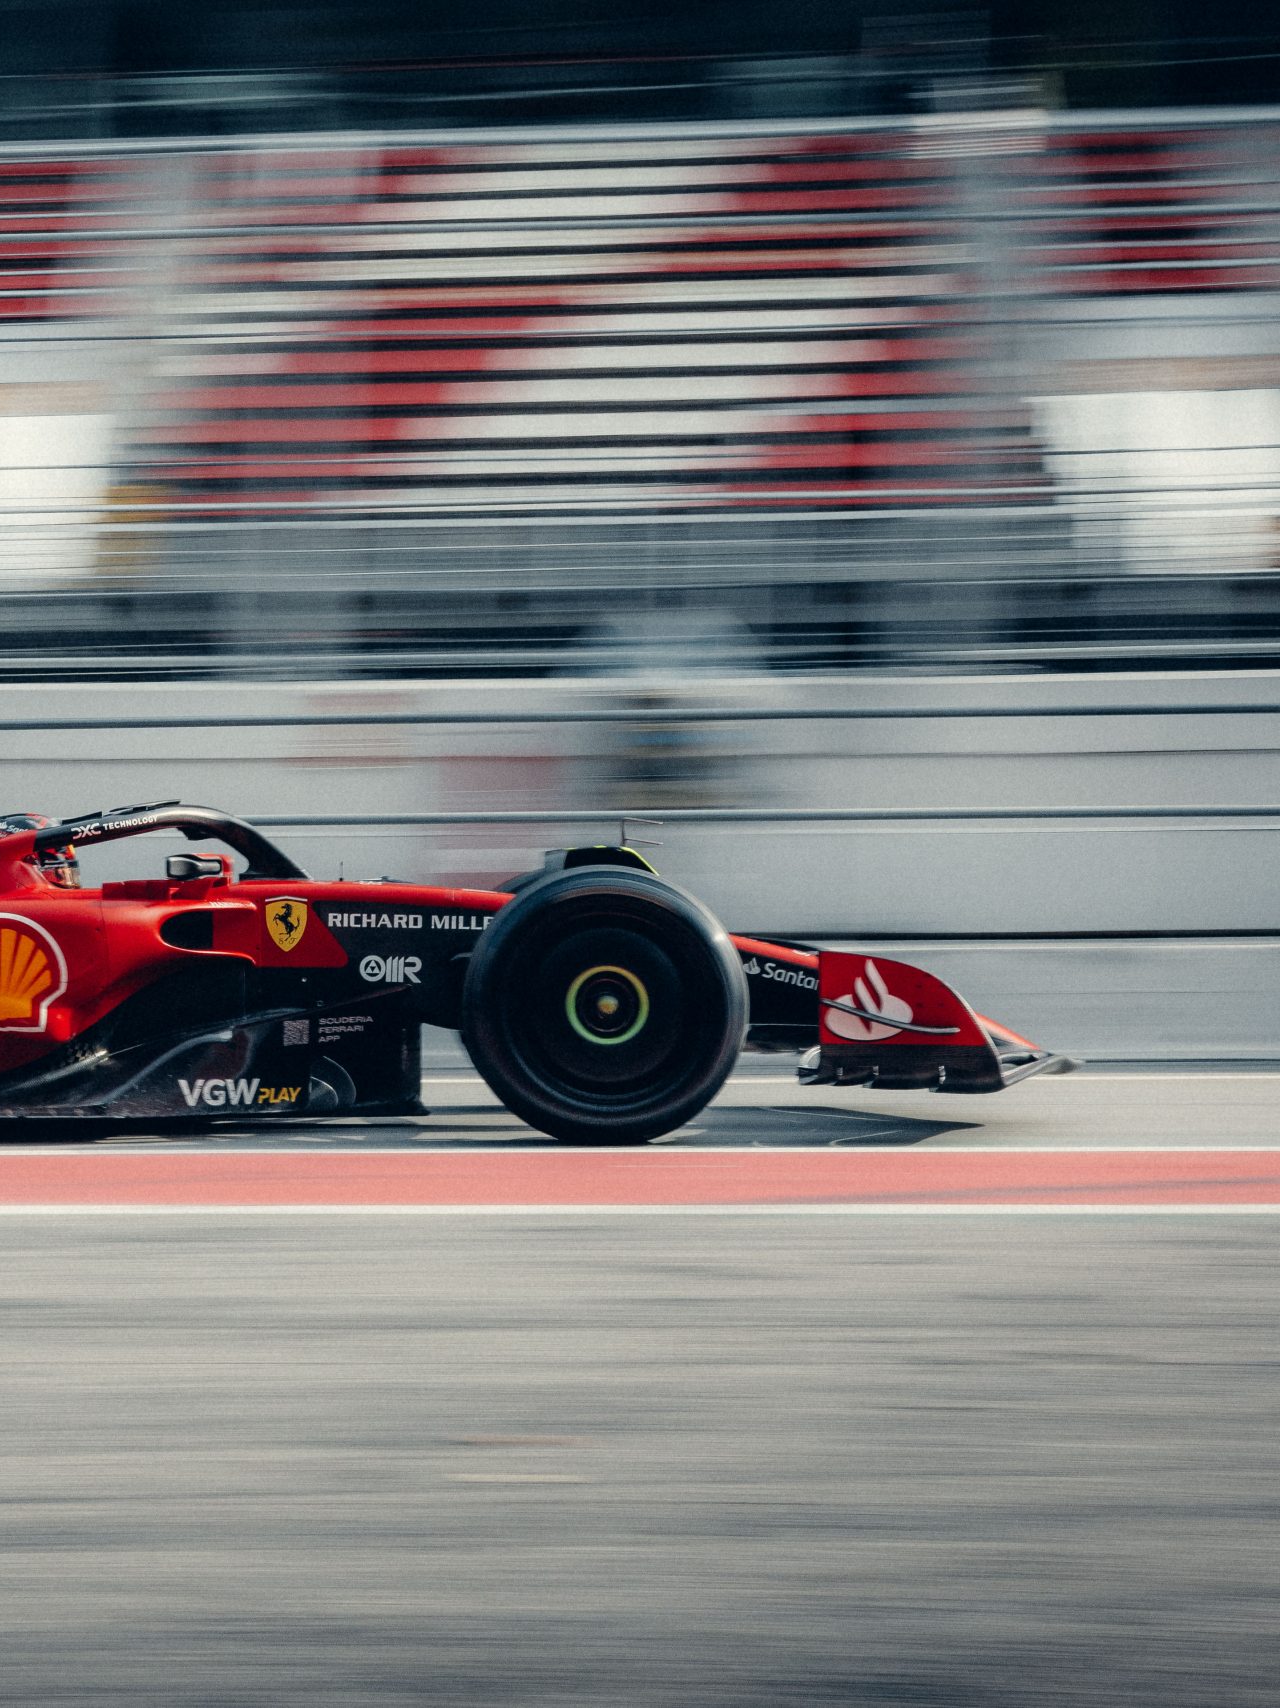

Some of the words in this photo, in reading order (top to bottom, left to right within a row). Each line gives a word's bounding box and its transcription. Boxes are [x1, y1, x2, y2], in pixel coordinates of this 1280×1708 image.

[103, 815, 158, 831] TECHNOLOGY
[328, 912, 423, 929] RICHARD
[319, 1015, 374, 1025] SCUDERIA
[318, 1025, 365, 1034] FERRARI
[318, 1035, 341, 1043] APP
[178, 1078, 261, 1107] VGW
[257, 1087, 302, 1104] PLAY
